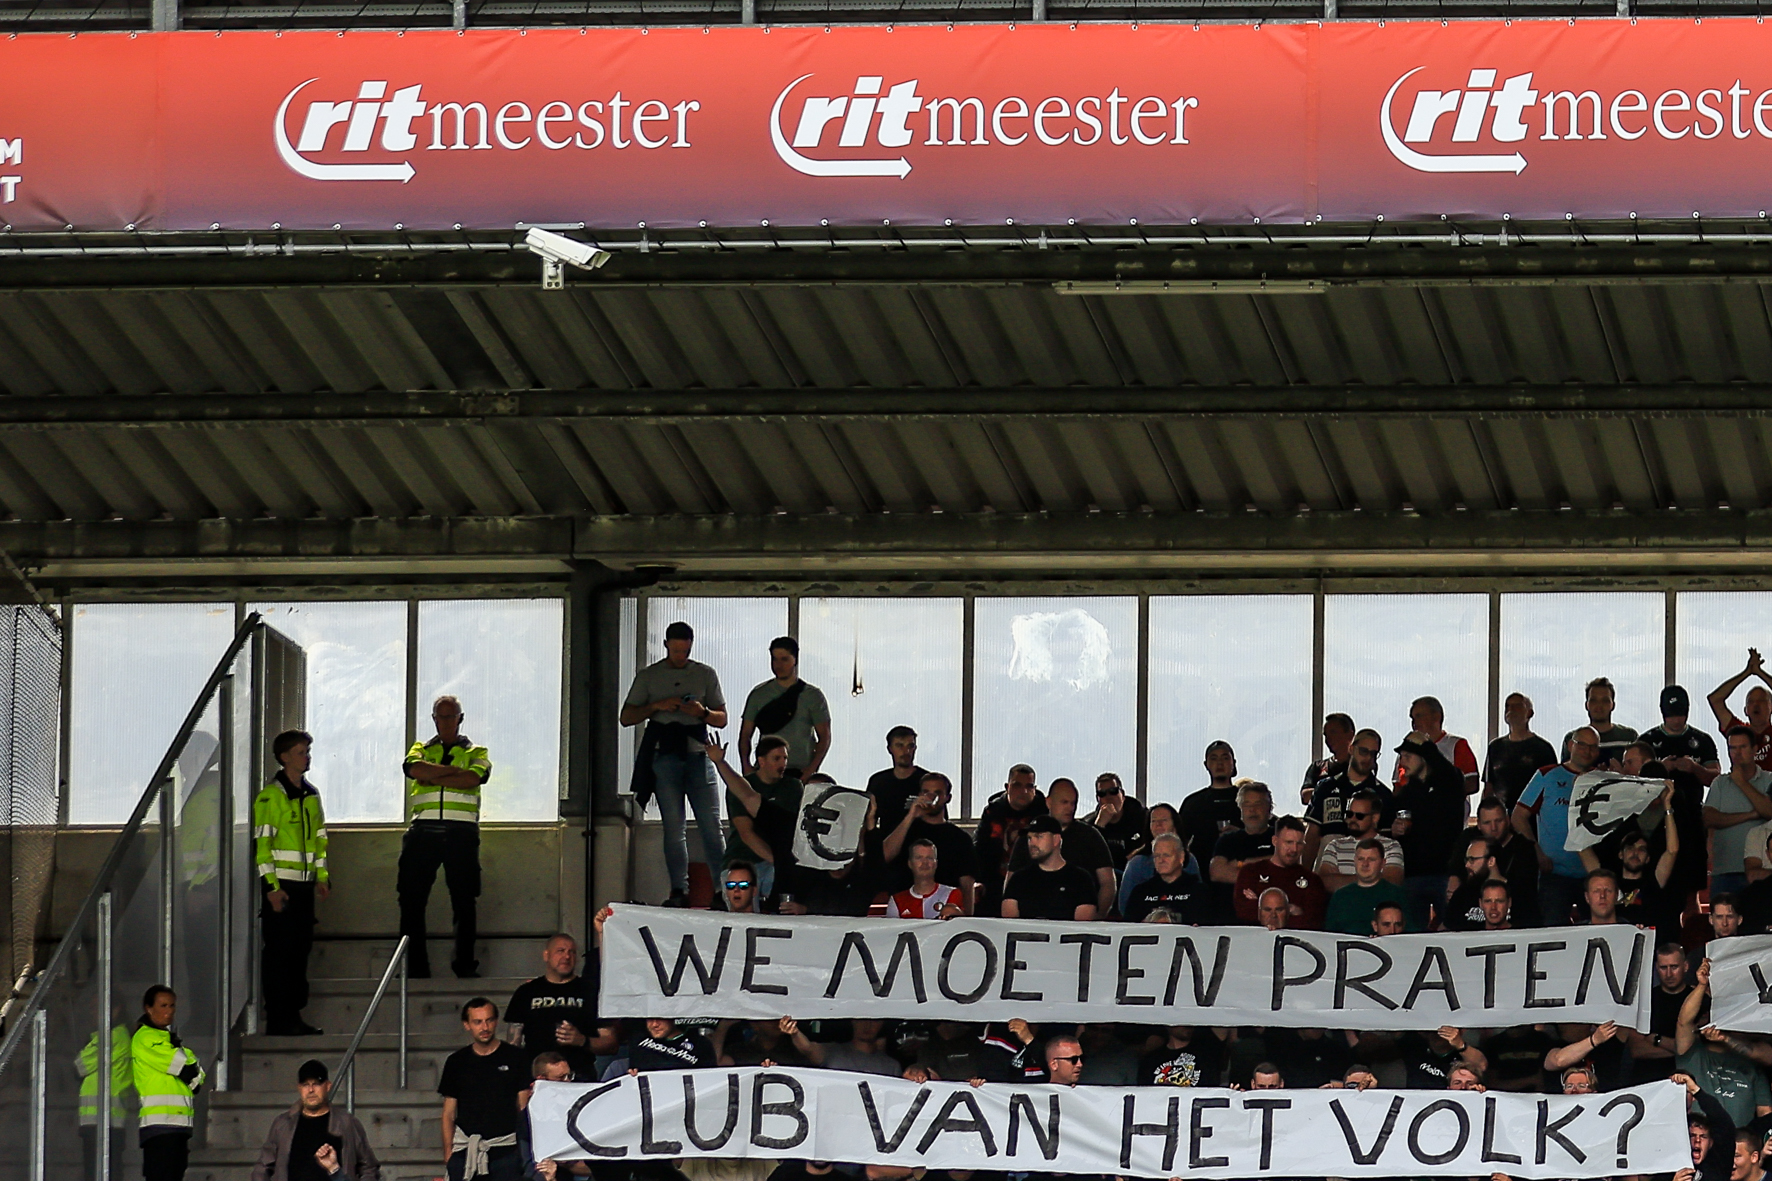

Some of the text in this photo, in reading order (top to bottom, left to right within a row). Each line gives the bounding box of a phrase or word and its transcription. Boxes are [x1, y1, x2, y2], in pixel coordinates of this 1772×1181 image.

[297, 80, 701, 152] ritmeester
[792, 76, 1198, 147] ritmeester
[639, 926, 1647, 1011] WE MOETEN PRATEN
[567, 1073, 1646, 1171] CLUB VAN HET VOLK?
